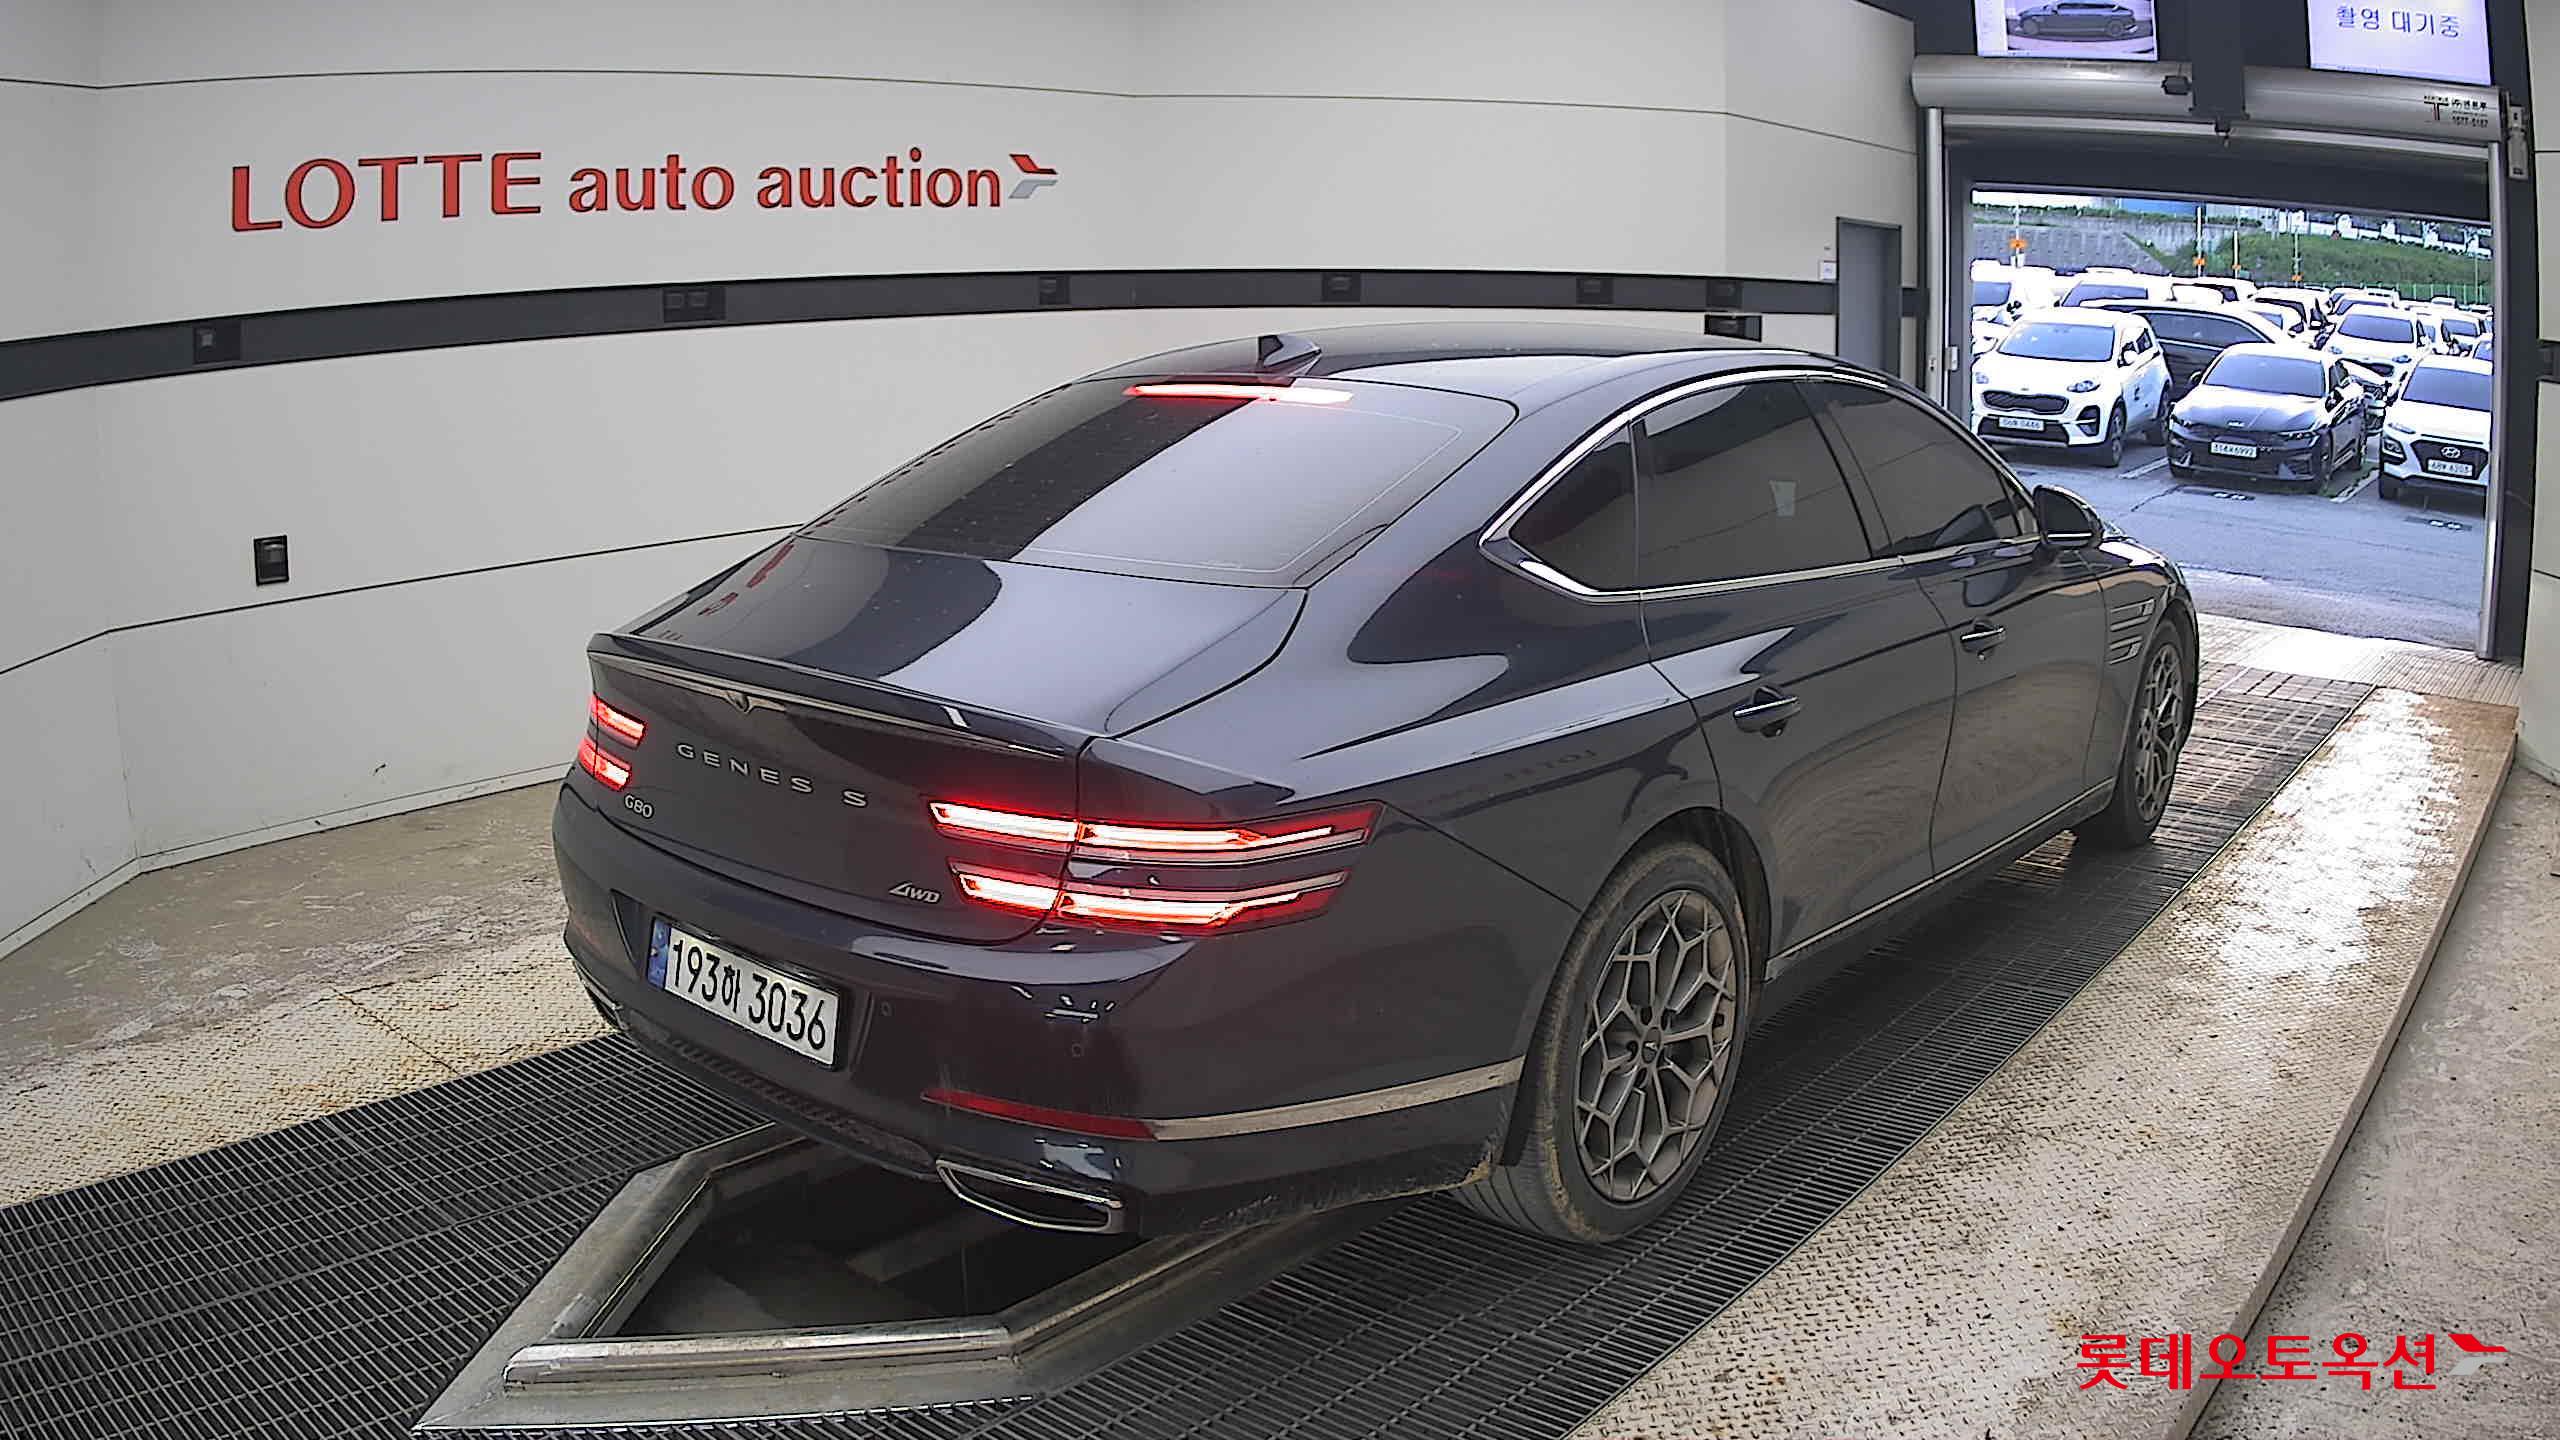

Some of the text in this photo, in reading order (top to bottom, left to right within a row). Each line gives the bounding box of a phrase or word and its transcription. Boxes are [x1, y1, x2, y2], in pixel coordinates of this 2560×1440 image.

[2391, 10, 2459, 38] 대기중
[231, 147, 1001, 232] LOTTE auto auction
[624, 794, 653, 818] G80
[889, 882, 941, 903] 4WD
[672, 939, 827, 1050] 193하 3036
